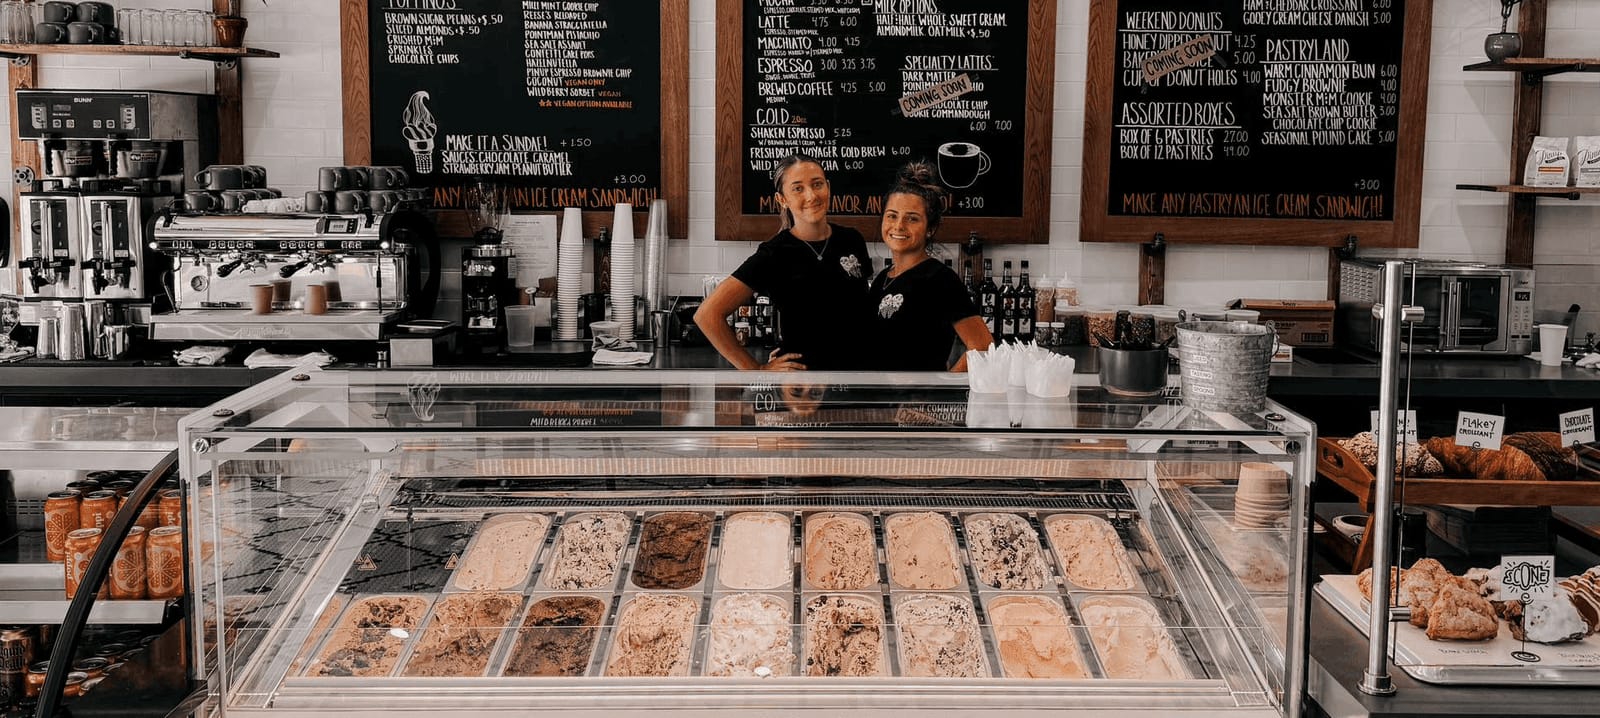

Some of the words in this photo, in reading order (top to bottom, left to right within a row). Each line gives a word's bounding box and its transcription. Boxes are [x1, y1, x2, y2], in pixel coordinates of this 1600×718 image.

[541, 1, 560, 10] MINT
[585, 3, 599, 12] CHIP
[874, 0, 898, 14] MILK
[1311, 0, 1364, 11] CROISSANT
[385, 12, 417, 24] BROWN
[419, 13, 445, 24] SUGAR
[446, 14, 477, 25] PECANS
[554, 11, 588, 20] RELOADED
[759, 15, 791, 28] LATTE
[812, 16, 829, 27] 4.75
[840, 16, 857, 27] 6.00
[949, 13, 977, 26] SWEET
[1126, 11, 1177, 30] WEEKEND
[1178, 11, 1223, 30] DONUTS
[1243, 11, 1271, 25] GOOEY
[1272, 11, 1301, 25] CREAM
[1302, 11, 1334, 26] CHEESE
[1335, 11, 1369, 26] DANISH
[1373, 12, 1392, 24] 5.00
[386, 25, 413, 34] SLICED
[416, 25, 455, 36] ALMONDS
[524, 21, 553, 30] BANANA
[928, 26, 965, 37] OATMILK
[387, 35, 423, 45] CRUSHED
[525, 30, 565, 40] POINTMAN
[1123, 33, 1158, 50] HONEY
[1235, 34, 1257, 49] 4.25
[524, 40, 539, 49] SEA
[540, 40, 557, 49] SALT
[558, 40, 586, 50] ASSAULT
[758, 37, 812, 50] MACCHIATO
[819, 36, 838, 47] 4.00
[1266, 38, 1350, 61] PASTRYLAND
[388, 45, 433, 55] SPRINKLES
[388, 54, 435, 65] CHOCOLATE
[437, 54, 460, 64] CHIPS
[904, 55, 956, 70] SPECIALTY
[1145, 50, 1185, 77] COMING
[1183, 38, 1215, 60] SOON
[1234, 51, 1256, 65] 5.00
[758, 58, 813, 73] ESPRESSO
[821, 58, 837, 70] 3.00
[842, 58, 856, 70] 3.25
[1263, 63, 1292, 79] WARM
[1294, 63, 1350, 79] CINNAMON
[1352, 63, 1376, 79] BUN
[1380, 64, 1397, 78] 6.00
[550, 68, 582, 78] ESPRESSO
[583, 69, 614, 78] BROWNIE
[615, 68, 632, 79] CHIP
[902, 71, 923, 82] DARK
[926, 71, 956, 82] MATTER
[1167, 69, 1207, 87] DONUT
[1207, 69, 1238, 87] HOLES
[1242, 70, 1261, 84] 4.00
[526, 77, 563, 87] COCONUT
[759, 81, 796, 96] BREWED
[797, 81, 834, 96] COFFEE
[840, 81, 857, 93] 4.25
[869, 81, 886, 93] 5.00
[1264, 78, 1300, 93] FUDGY
[1302, 78, 1347, 93] BROWNIE
[527, 87, 546, 97] WILD
[546, 87, 569, 97] BERRY
[570, 88, 595, 97] SORBET
[902, 89, 941, 112] COMING
[940, 78, 968, 97] SOON
[971, 100, 988, 110] CHIP
[1263, 92, 1314, 106] MONSTER
[1340, 92, 1373, 106] COOKIE
[756, 108, 790, 124] COLD
[931, 109, 990, 119] COMMANDOUGH
[1121, 101, 1193, 126] ASSORTED
[1194, 101, 1236, 126] BOXES
[1262, 105, 1281, 119] SEA
[1284, 105, 1307, 119] SALT
[1308, 105, 1340, 119] BROWN
[1342, 105, 1378, 119] BUTTER
[1272, 118, 1323, 130] CHOCOLATE
[1325, 118, 1344, 130] CHIP
[1346, 118, 1377, 130] COOKIE
[750, 127, 786, 139] SHAKEN
[788, 127, 826, 139] ESPRESSO
[1120, 128, 1139, 144] BOX
[1140, 128, 1153, 144] OF
[1155, 128, 1163, 144] 6
[1165, 128, 1215, 145] PASTRIES
[1223, 130, 1249, 143] 27.00
[1261, 130, 1311, 145] SEASONAL
[1312, 130, 1346, 145] POUND
[1347, 130, 1374, 145] CAKE
[1378, 130, 1396, 144] 5.00
[446, 135, 474, 150] MAKE
[477, 135, 488, 150] IT
[491, 135, 499, 150] A
[502, 135, 548, 151] SUNDAE!
[801, 146, 838, 158] VOYAGER
[841, 146, 860, 158] COLD
[861, 146, 886, 158] BREW
[891, 146, 911, 155] 6.00
[1120, 145, 1139, 159] BOX
[1140, 145, 1152, 160] OF
[1154, 145, 1165, 160] 12
[1165, 145, 1214, 161] PASTRIES
[1223, 145, 1250, 157] 49.00
[442, 163, 494, 175] STRAWBERRY
[512, 163, 542, 176] PEANUT
[543, 163, 573, 176] BUTTER
[750, 160, 772, 171] WILD
[1354, 179, 1380, 191] +3.00
[433, 187, 461, 207] ANY
[531, 187, 549, 208] ICE
[551, 187, 587, 208] CREAM
[958, 196, 984, 209] +3.00
[1122, 192, 1157, 214] MAKE
[1161, 192, 1185, 215] ANY
[1189, 192, 1233, 215] PASTRY
[1233, 193, 1250, 216] AN
[1252, 193, 1271, 217] ICE
[1276, 193, 1310, 216] CREAM
[1314, 193, 1384, 218] SANDWICH!
[1564, 414, 1593, 428] CHOCOLATE
[1502, 562, 1550, 591] SCONE
